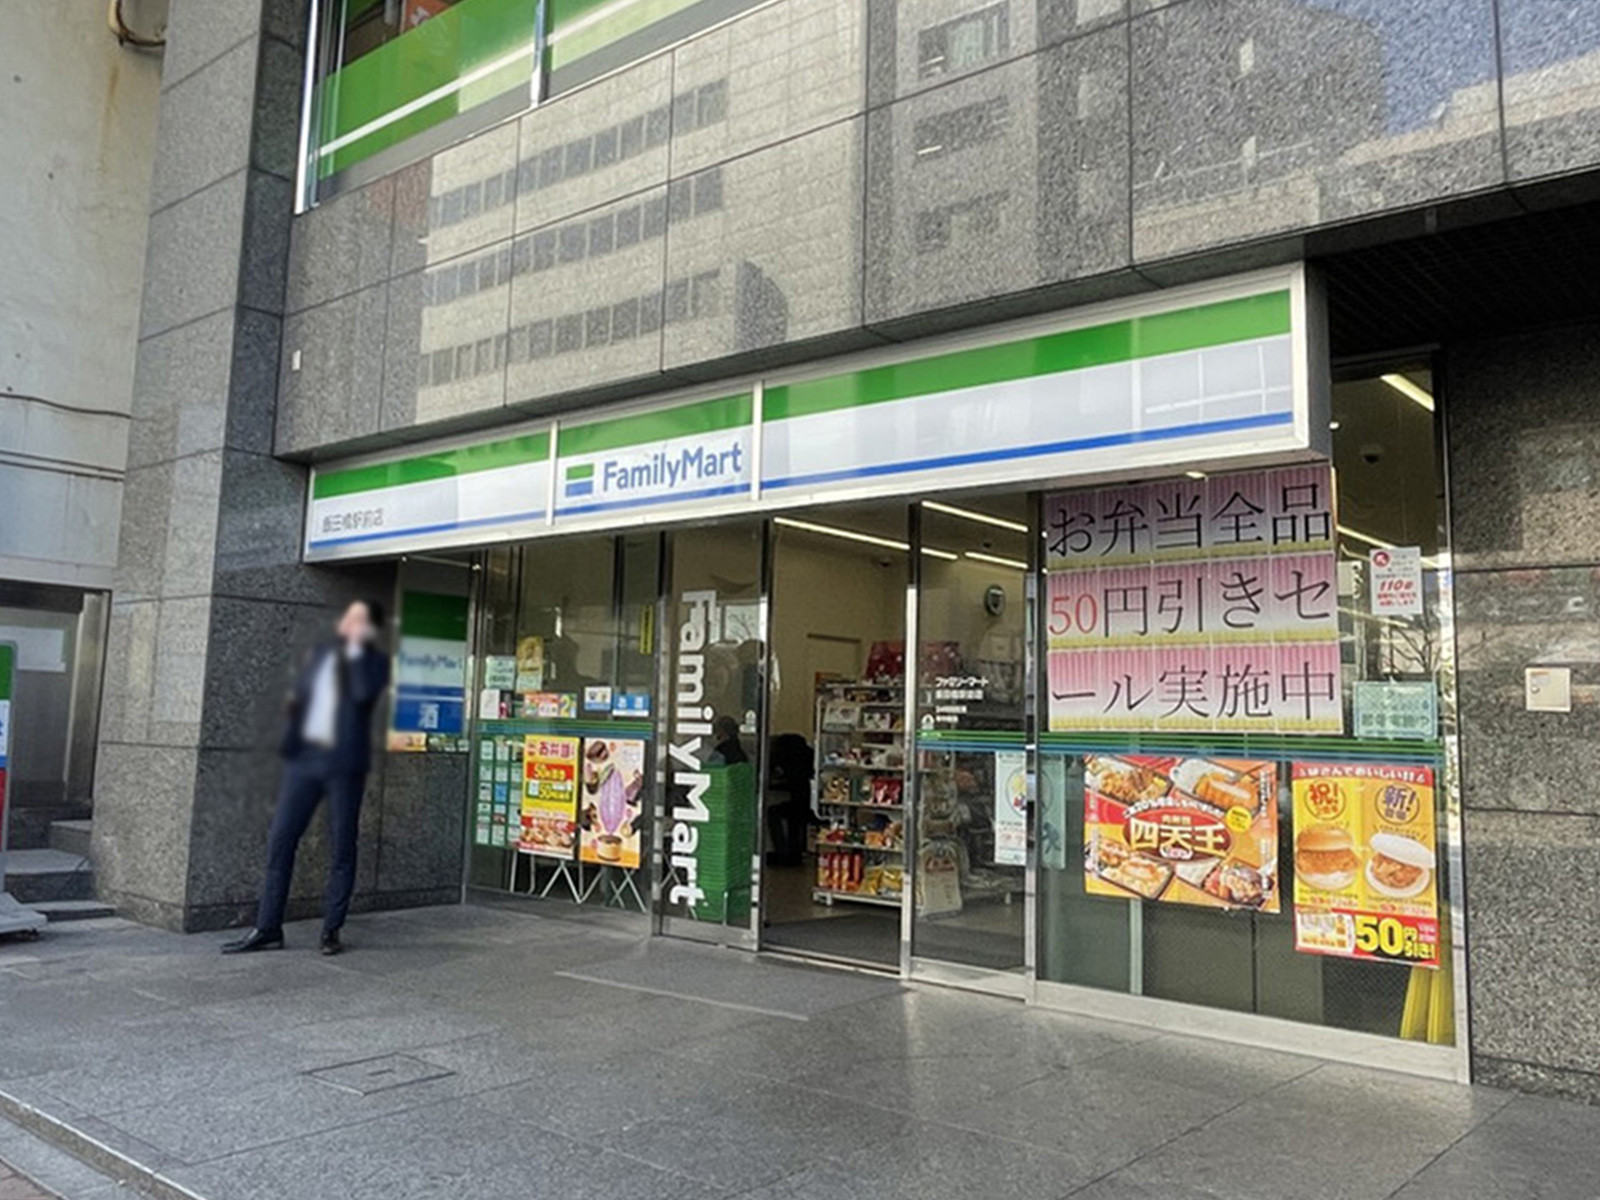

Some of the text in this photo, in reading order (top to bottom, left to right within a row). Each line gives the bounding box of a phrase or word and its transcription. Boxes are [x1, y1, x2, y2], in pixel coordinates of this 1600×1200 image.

[603, 440, 743, 491] FamilyMart
[1048, 480, 1331, 557] お弁当全品
[1048, 569, 1332, 638] 50円引きセ
[1051, 660, 1335, 720] ール実施中
[668, 590, 718, 906] FamilyMart
[1129, 816, 1228, 860] 四天王
